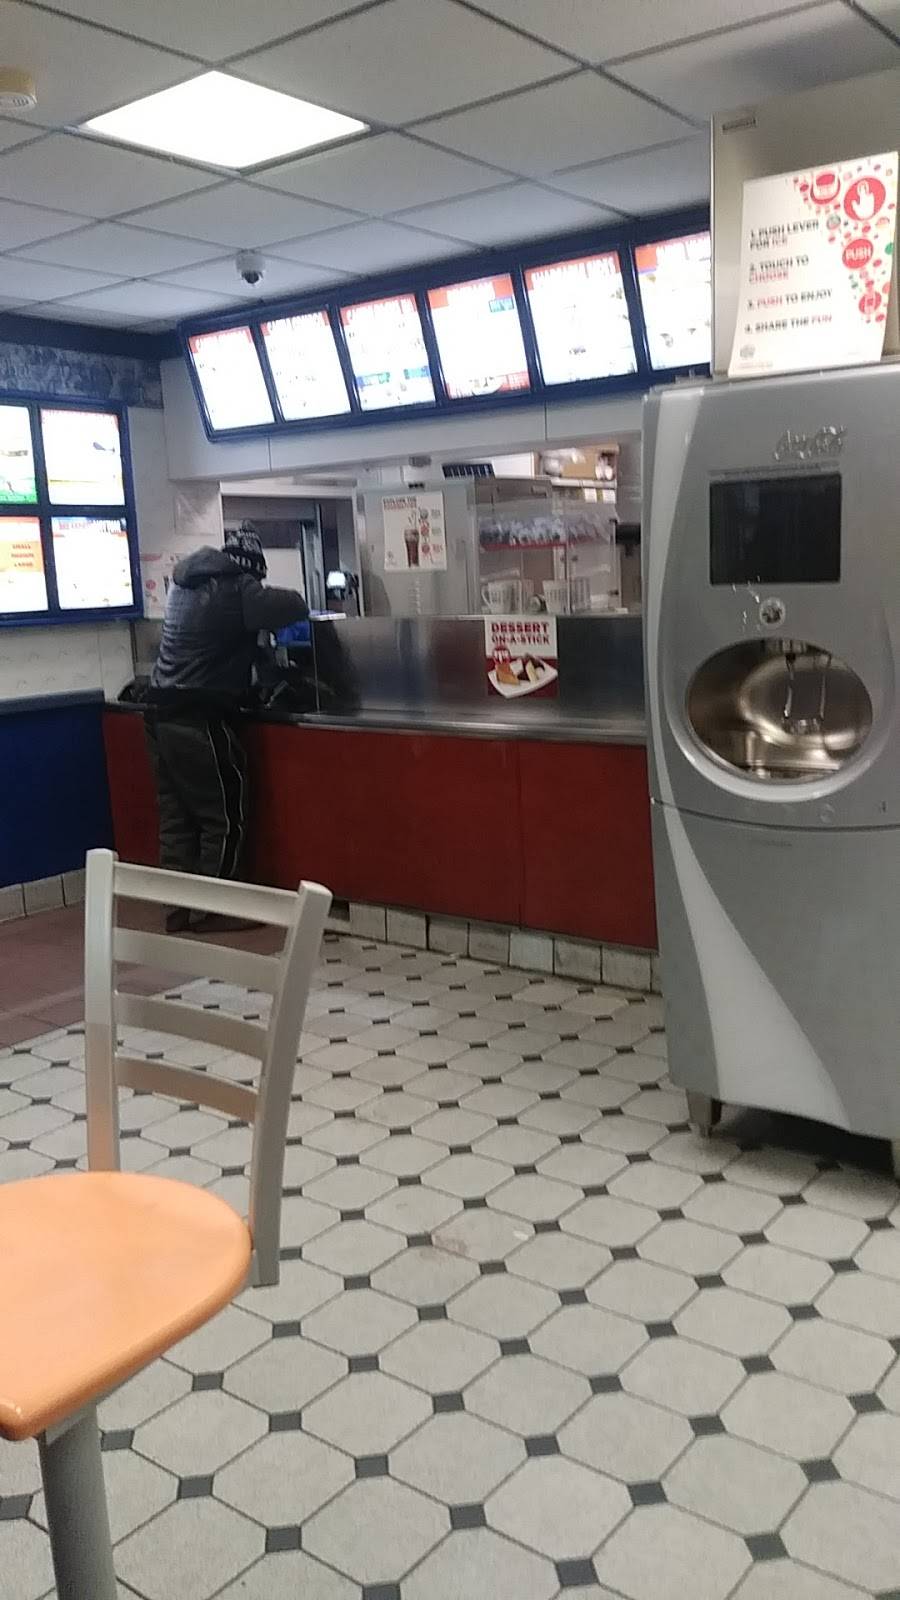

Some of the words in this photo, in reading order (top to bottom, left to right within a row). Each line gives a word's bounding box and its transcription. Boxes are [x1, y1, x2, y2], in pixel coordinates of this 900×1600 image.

[758, 223, 785, 238] PUSH
[786, 219, 819, 234] LEVER
[749, 238, 769, 251] FOR
[846, 247, 870, 260] PUSH
[759, 256, 793, 271] TOUCH
[795, 254, 810, 266] TO
[756, 296, 783, 309] PUSH
[785, 292, 799, 305] TO
[800, 288, 832, 303] ENJOY
[754, 318, 787, 332] SHARE
[790, 315, 809, 328] THE
[811, 313, 833, 325] FUN
[490, 621, 549, 634] DESSERT
[491, 633, 550, 645] ON-A-STICK
